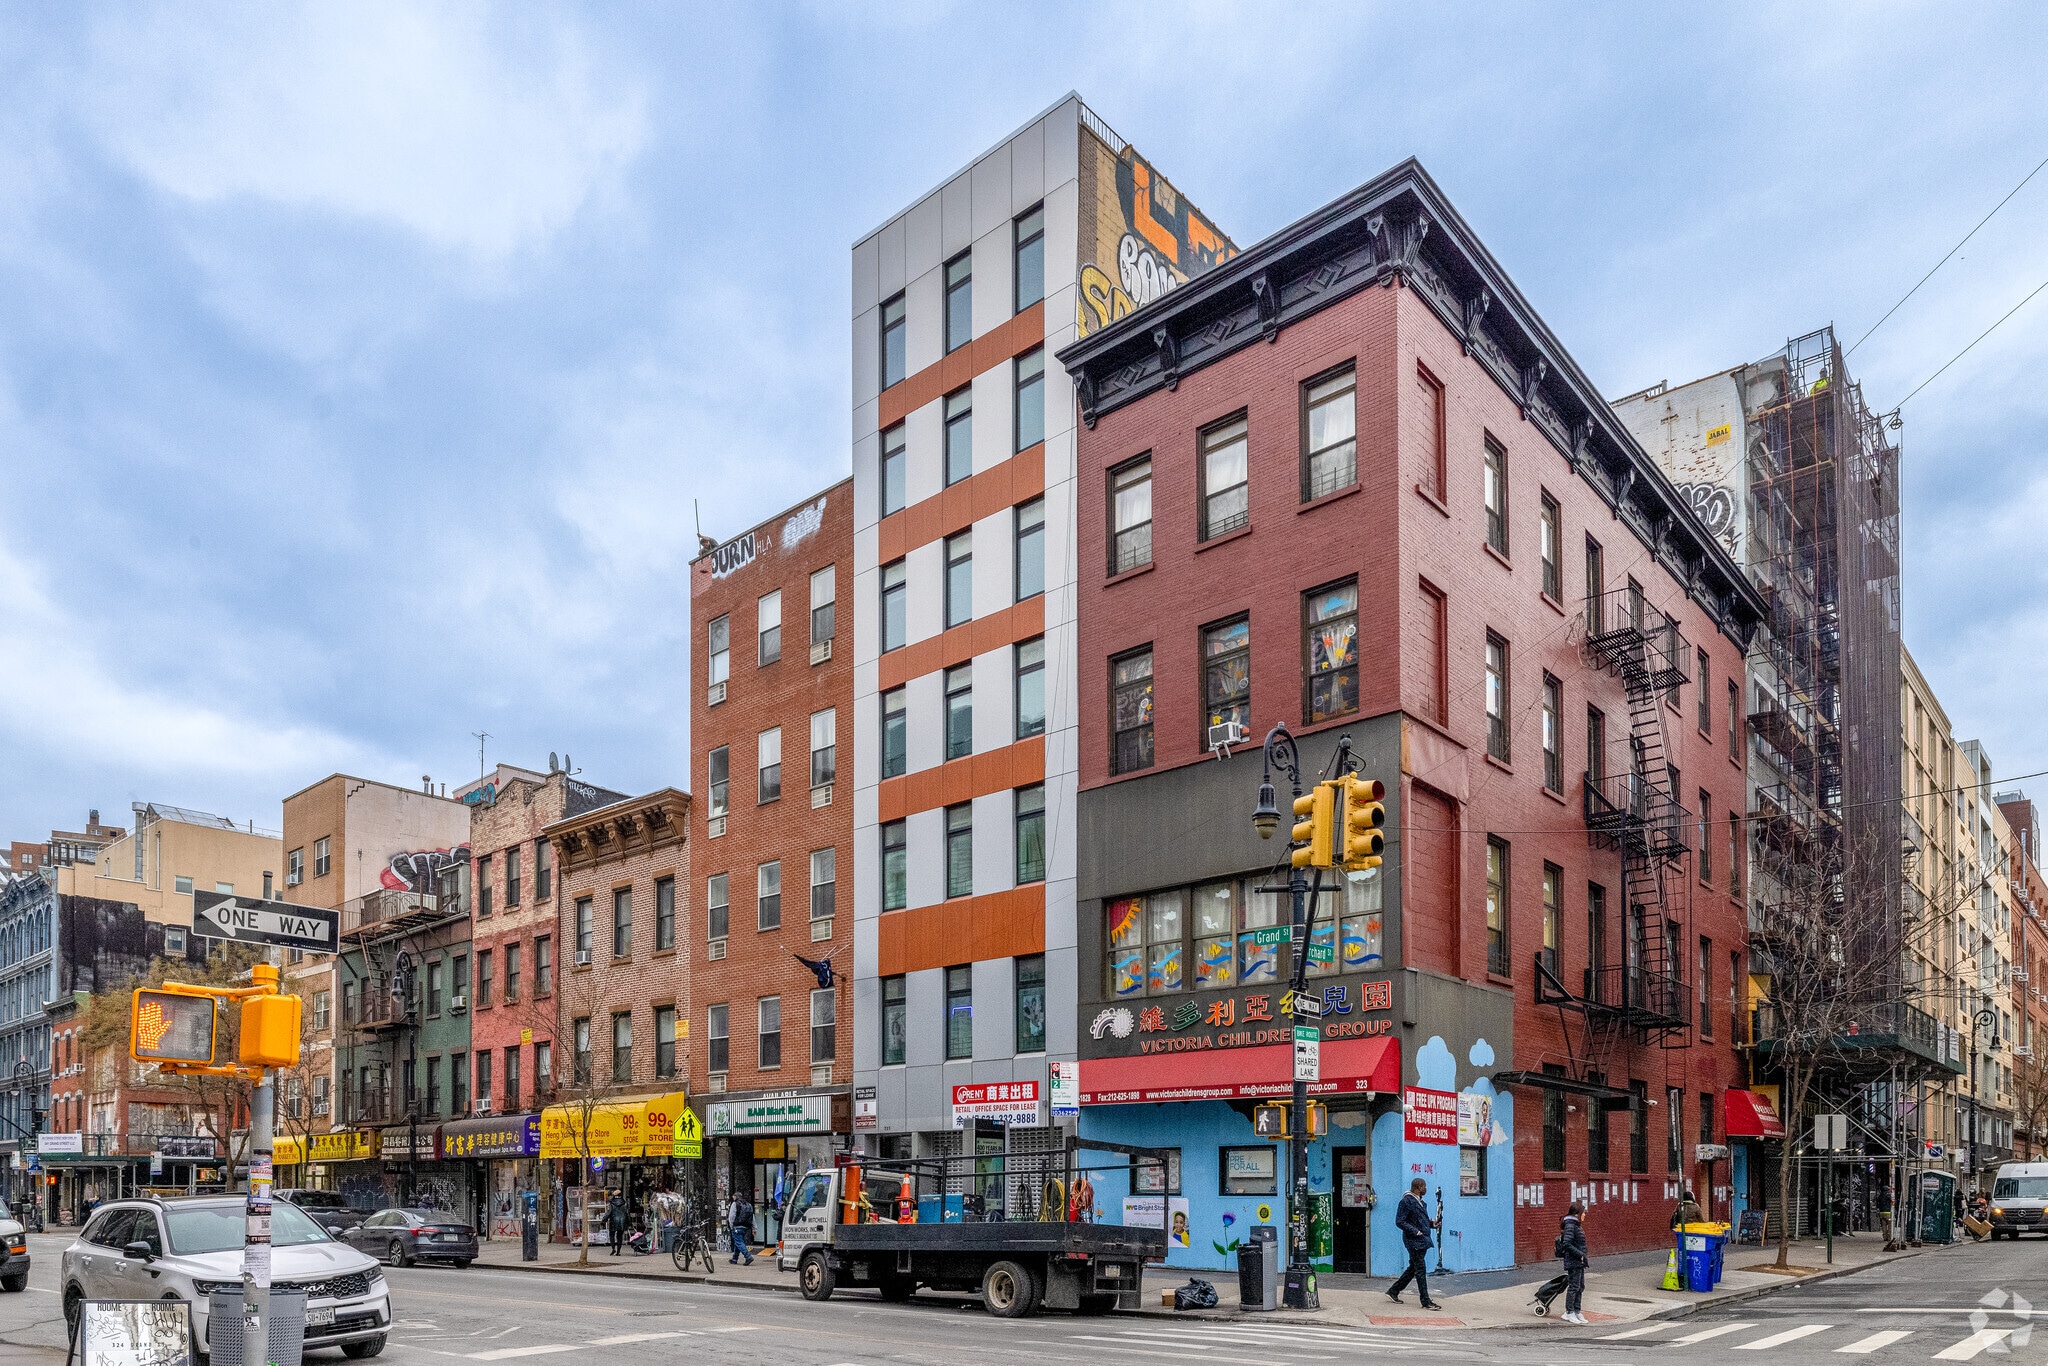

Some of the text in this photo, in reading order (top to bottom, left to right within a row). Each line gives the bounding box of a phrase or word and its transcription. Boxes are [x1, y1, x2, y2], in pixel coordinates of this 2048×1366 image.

[217, 907, 321, 938] ONE WAY
[1257, 927, 1289, 944] Grand St
[1308, 948, 1327, 960] rchard
[1296, 998, 1318, 1012] ONE WAY
[1140, 1019, 1392, 1053] VICTORIA CHILDRE GROUP
[1296, 1057, 1318, 1067] SHARED
[1300, 1068, 1314, 1077] LANE
[1054, 1081, 1059, 1089] 2
[1145, 1086, 1233, 1100] www.victoriachildrensgroup.com
[1355, 1080, 1368, 1090] 323
[975, 1089, 985, 1098] NY
[986, 1083, 1034, 1101] 商業出租
[1415, 1092, 1457, 1112] FREE UPK PROGRAM
[955, 1105, 971, 1114] RETAIL
[975, 1104, 993, 1113] OFFICE
[993, 1104, 1009, 1112] SPACE
[1010, 1103, 1020, 1111] FOR
[1021, 1102, 1037, 1111] LEASE
[545, 1131, 560, 1140] Heng
[594, 1129, 610, 1138] Store
[648, 1134, 673, 1142] STORE
[623, 1136, 639, 1144] STORE
[675, 1146, 700, 1155] SCHOOL
[1230, 1155, 1245, 1163] PRE
[1229, 1162, 1260, 1171] FOR ALL
[1138, 1204, 1154, 1212] Bright
[318, 1312, 333, 1321] 7694
